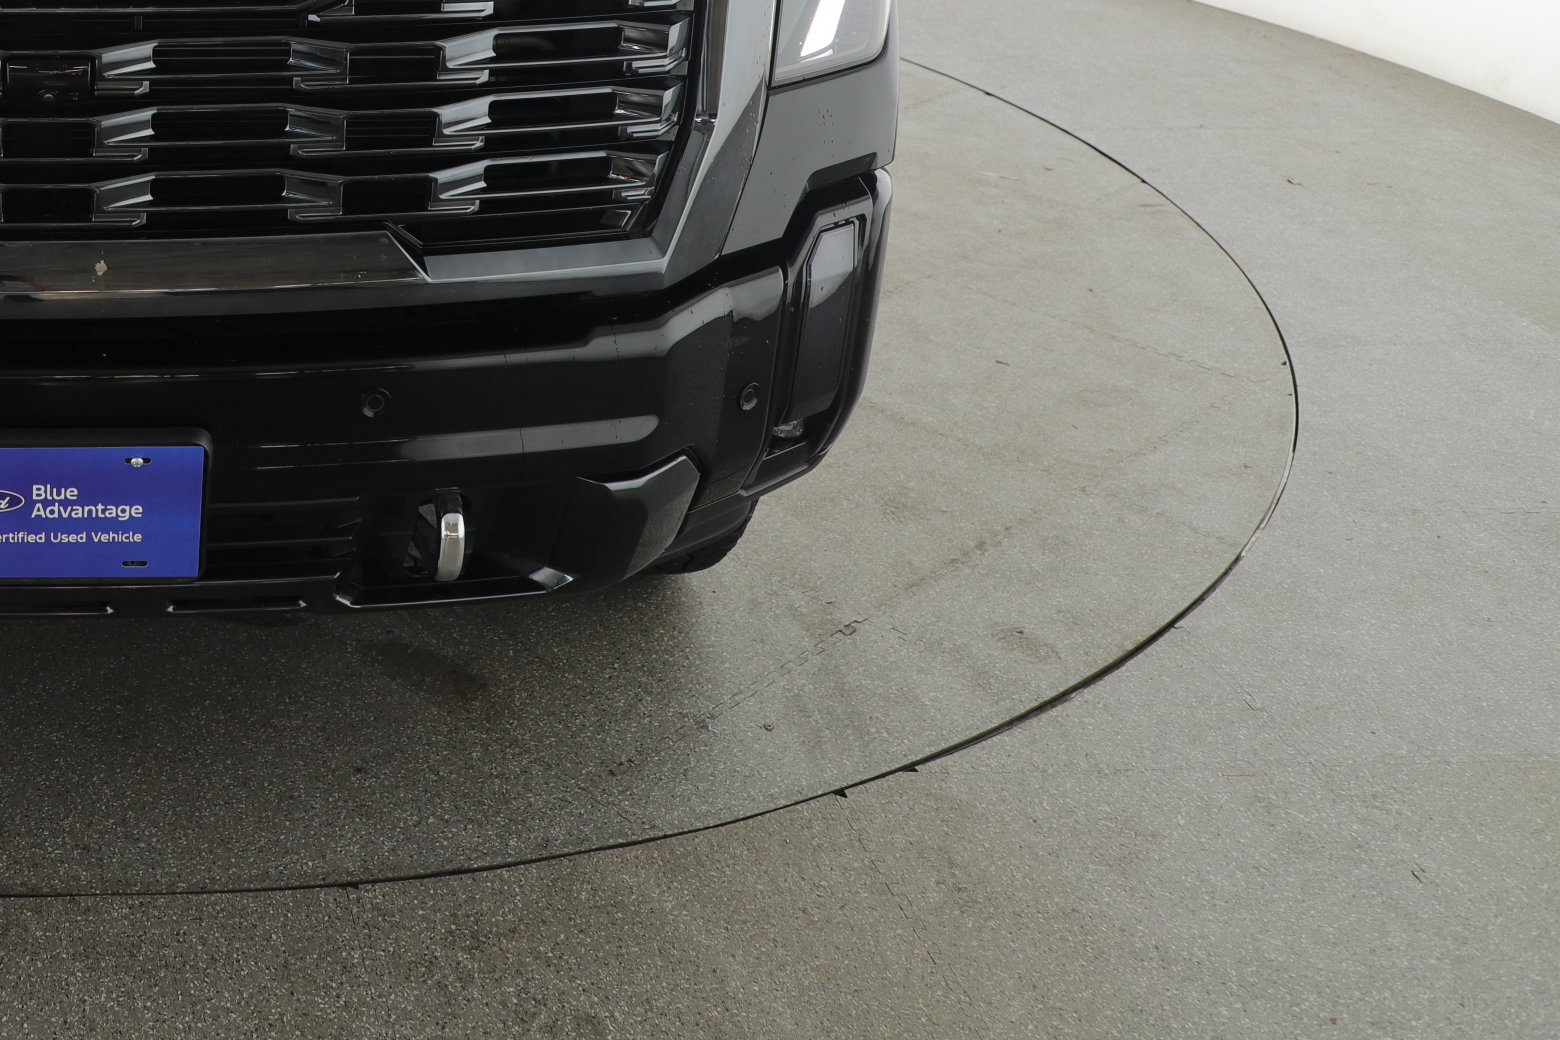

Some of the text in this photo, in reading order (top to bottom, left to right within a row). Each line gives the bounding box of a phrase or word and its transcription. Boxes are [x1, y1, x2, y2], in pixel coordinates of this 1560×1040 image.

[32, 483, 79, 501] Blue
[30, 502, 144, 521] Advantage
[50, 530, 87, 543] Used
[91, 530, 143, 543] Vehicle
